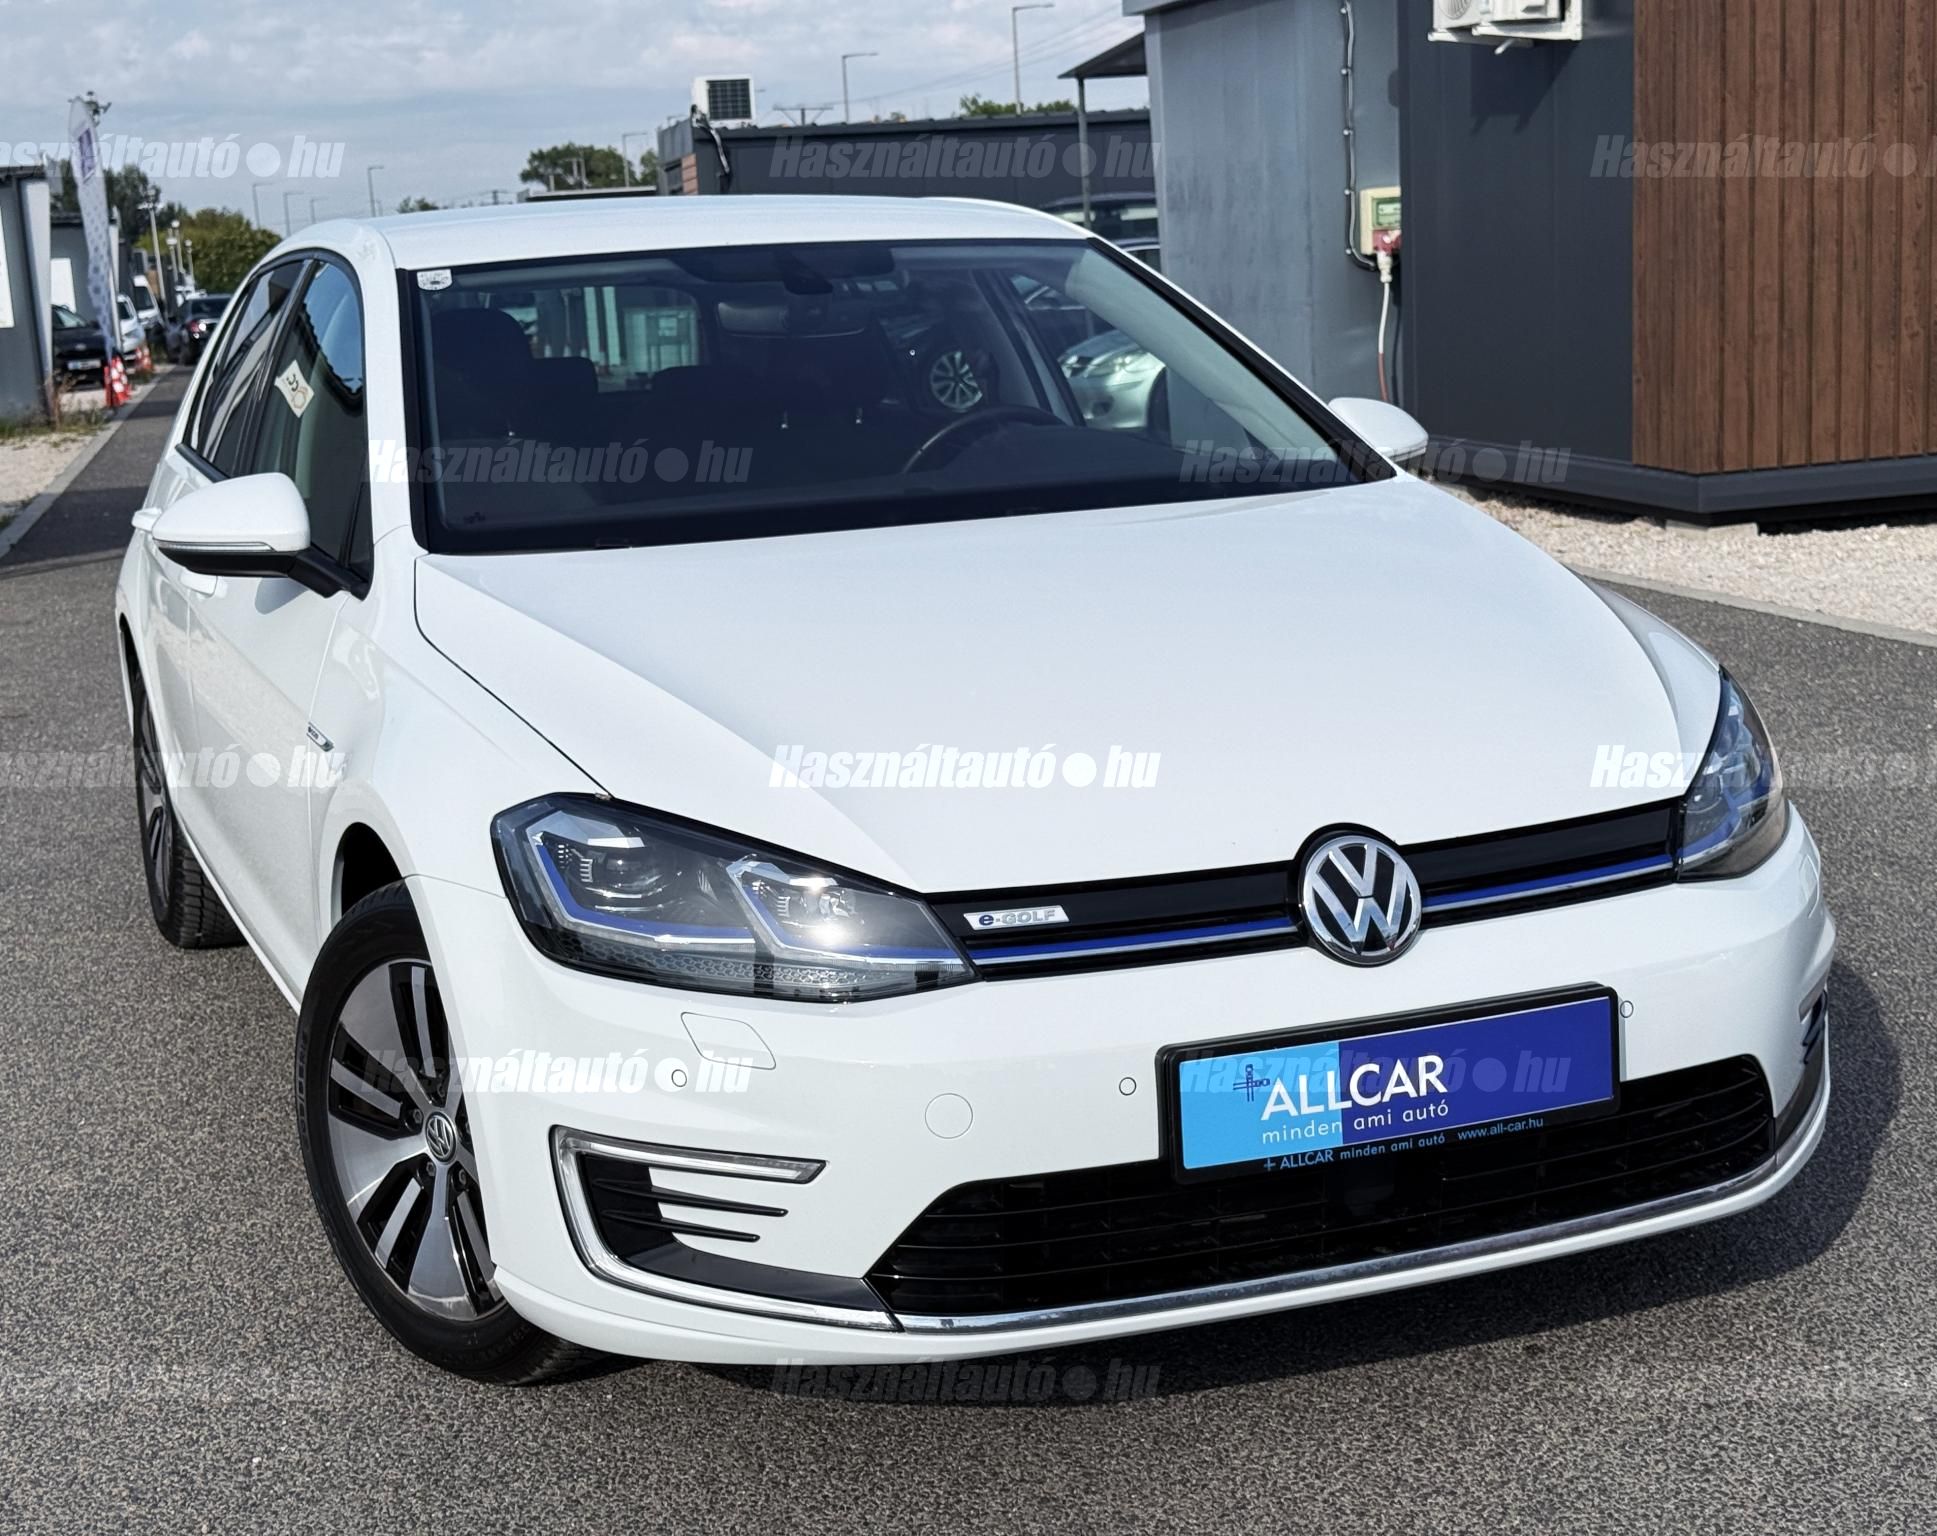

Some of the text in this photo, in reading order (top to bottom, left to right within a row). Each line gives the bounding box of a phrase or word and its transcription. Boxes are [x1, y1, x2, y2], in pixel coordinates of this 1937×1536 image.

[978, 909, 1056, 926] e-GOLF
[1260, 1055, 1448, 1121] ALLCAR
[1262, 1099, 1449, 1144] minden ami autó
[1280, 1118, 1544, 1170] ALLCAR minden ami autó www.all-car.hu
